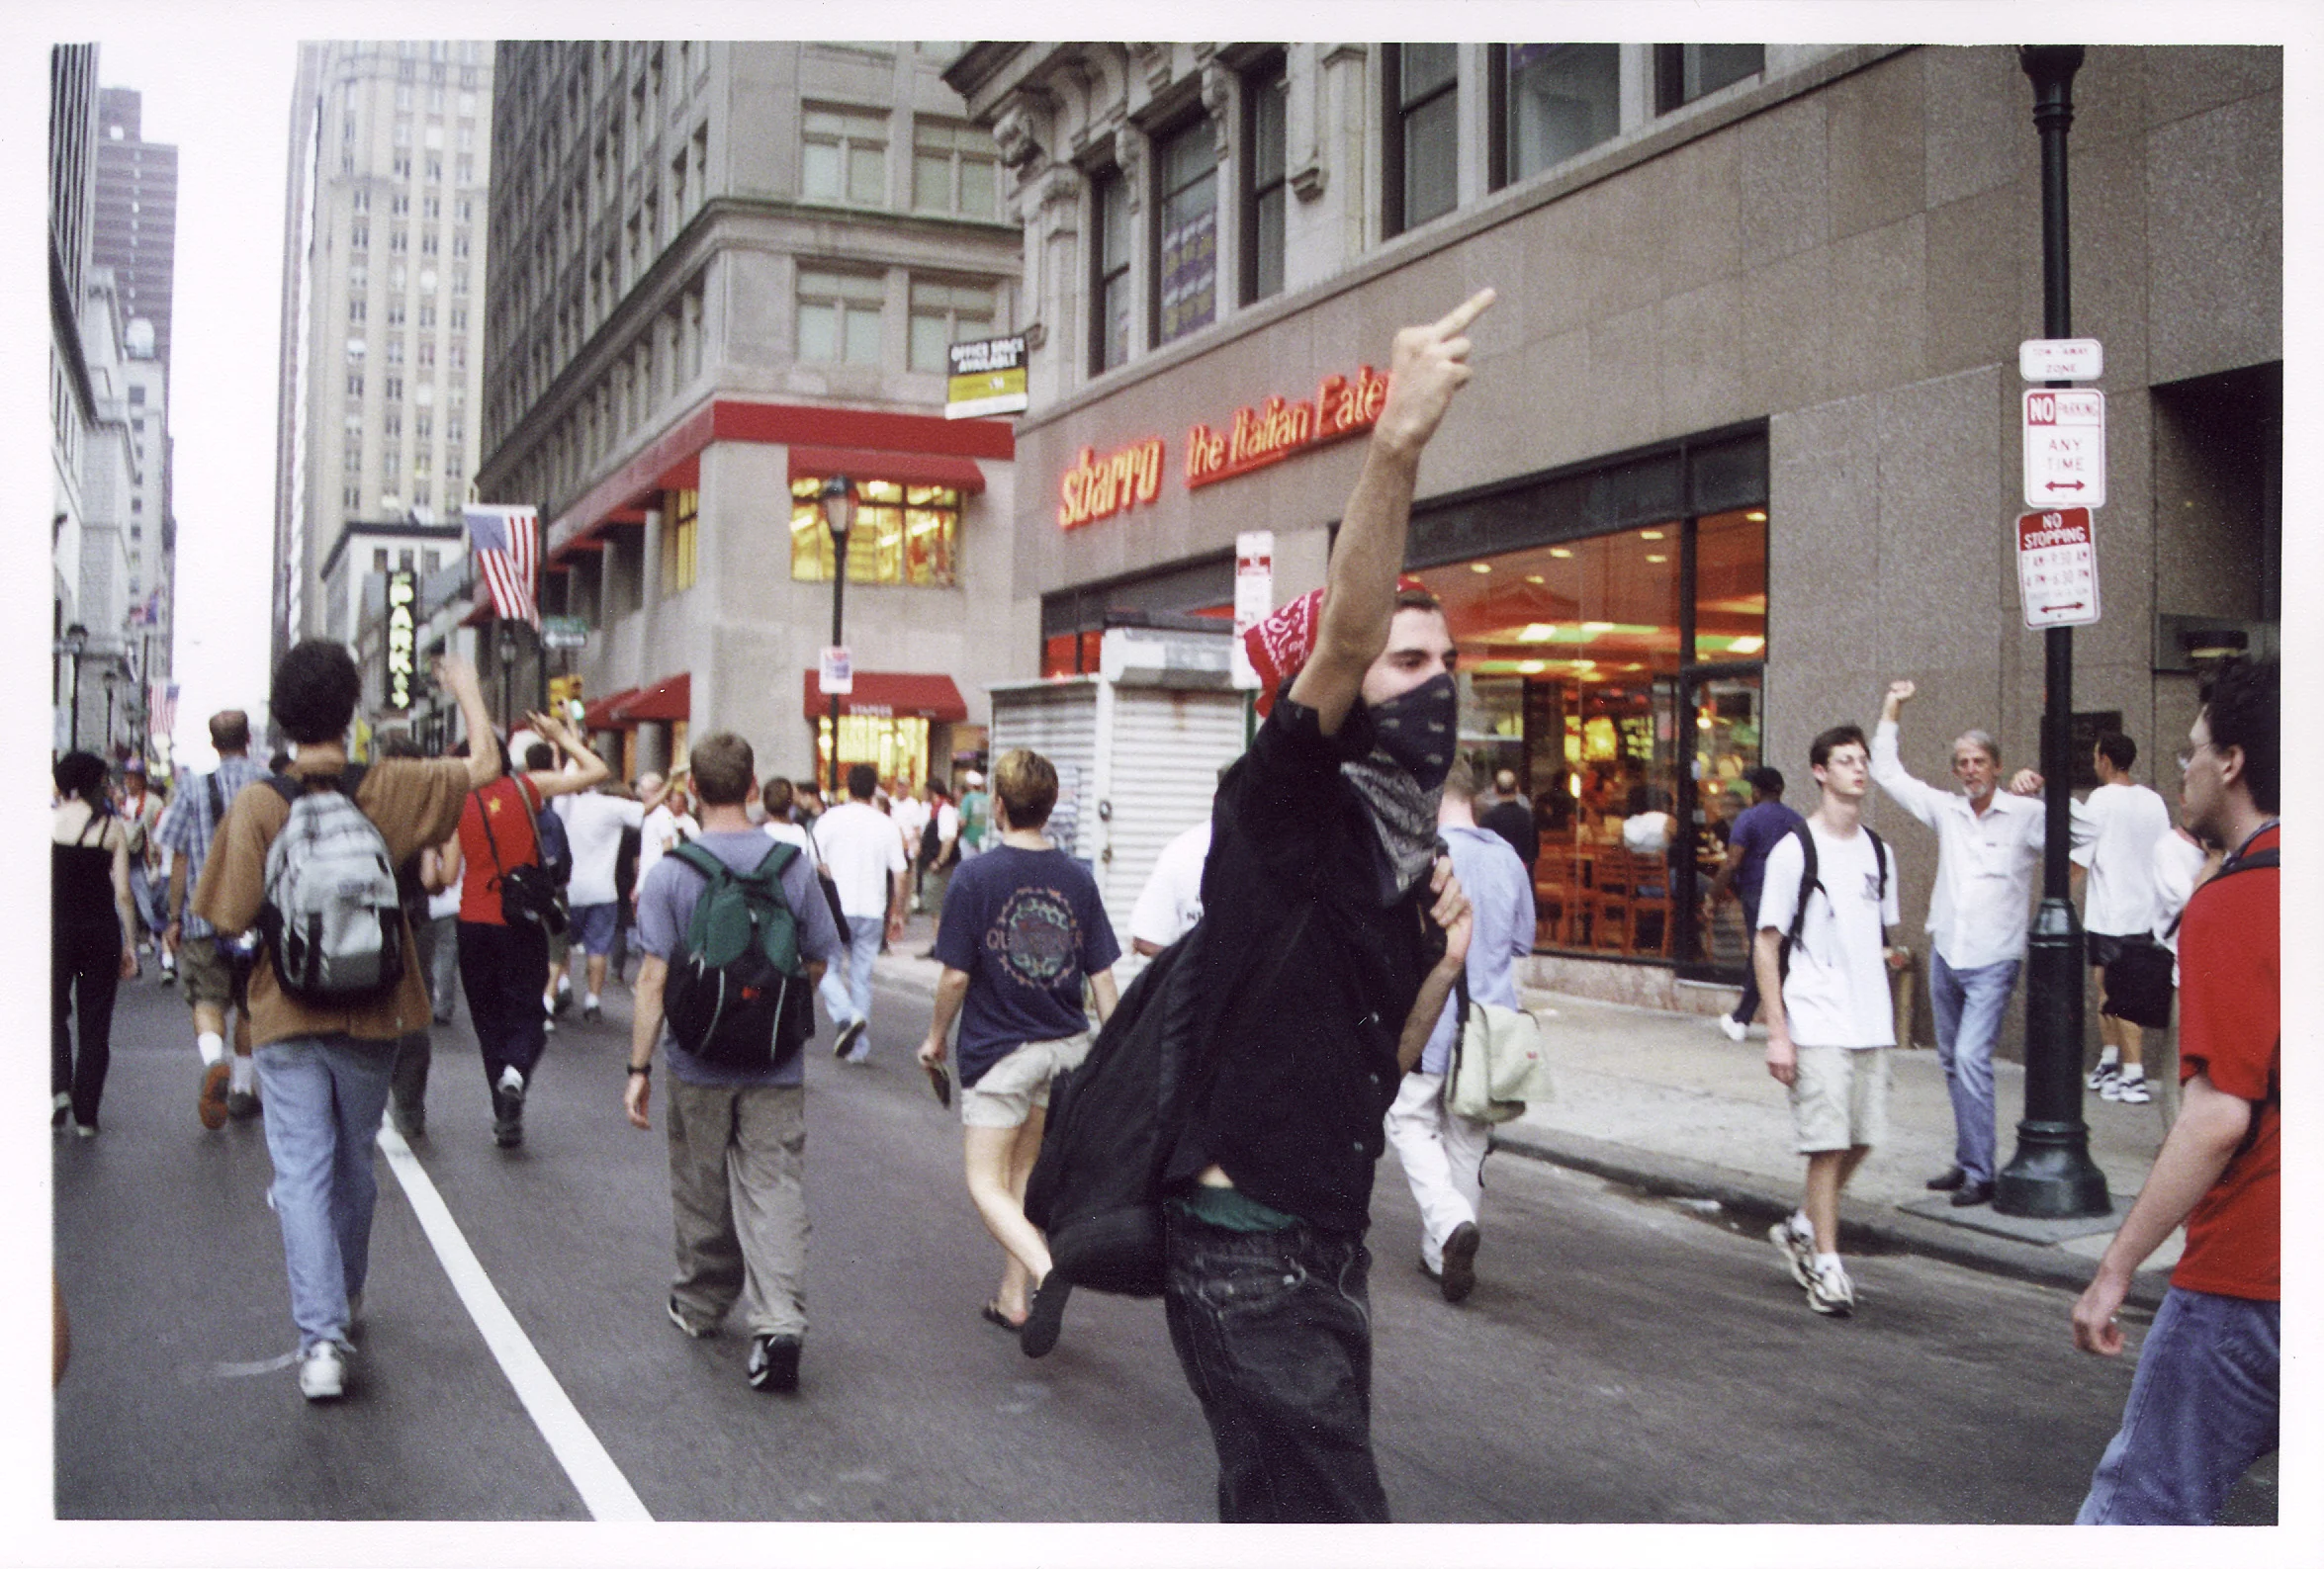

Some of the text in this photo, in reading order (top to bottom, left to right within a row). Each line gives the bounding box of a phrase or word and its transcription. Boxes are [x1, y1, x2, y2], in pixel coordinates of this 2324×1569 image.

[2046, 363, 2077, 374] ZONE
[2030, 396, 2054, 422] NO
[1058, 366, 1390, 530] sbarro the Italian Eate
[2048, 438, 2084, 452] ANY
[2047, 457, 2085, 472] TIME
[2042, 512, 2062, 529] NO
[2023, 526, 2087, 550] STOPPING
